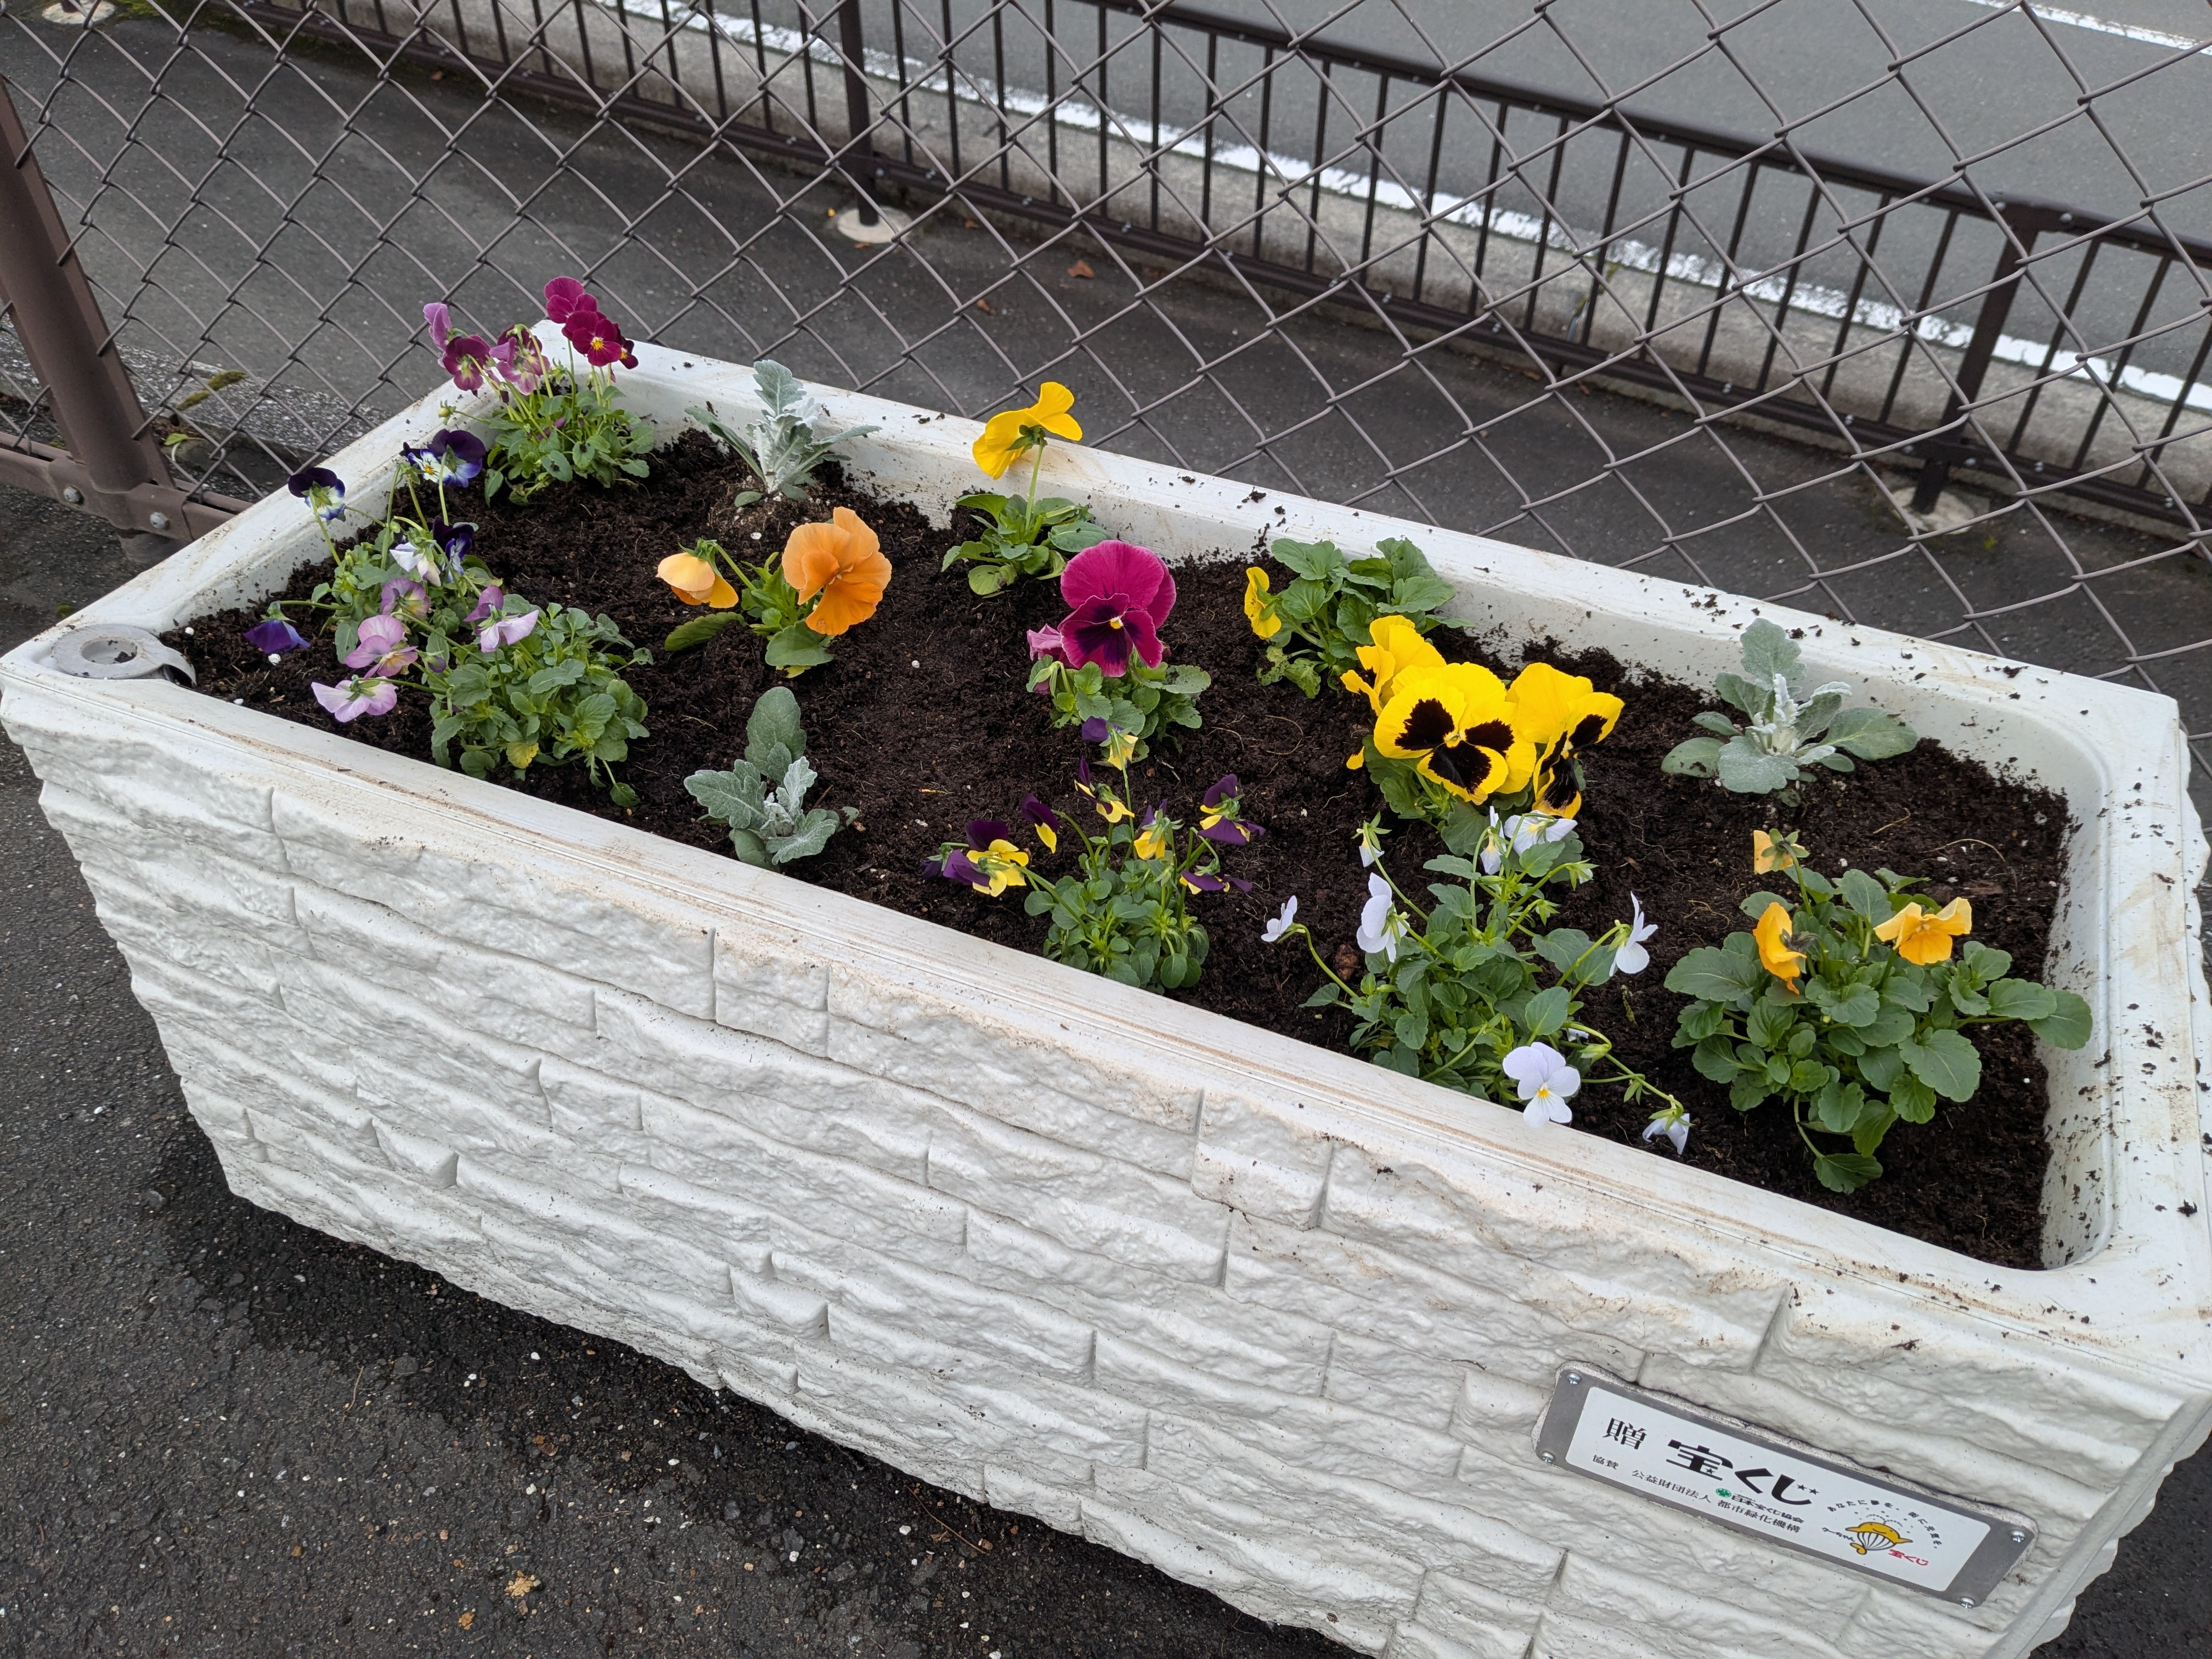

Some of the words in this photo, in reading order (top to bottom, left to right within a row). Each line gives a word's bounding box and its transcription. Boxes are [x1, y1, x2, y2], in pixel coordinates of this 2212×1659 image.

[1602, 1417, 1647, 1450] 贈
[1666, 1438, 1820, 1505] 宝くじ
[1592, 1454, 1619, 1470] 協賛
[1632, 1470, 1712, 1503] 公益財団法人
[1717, 1499, 1801, 1533] 都市緑化機構
[1731, 1495, 1805, 1524] 日本宝くじ協会
[1827, 1499, 1942, 1549] あなたにを。街に元を。
[1888, 1549, 1929, 1566] 宝くじ
